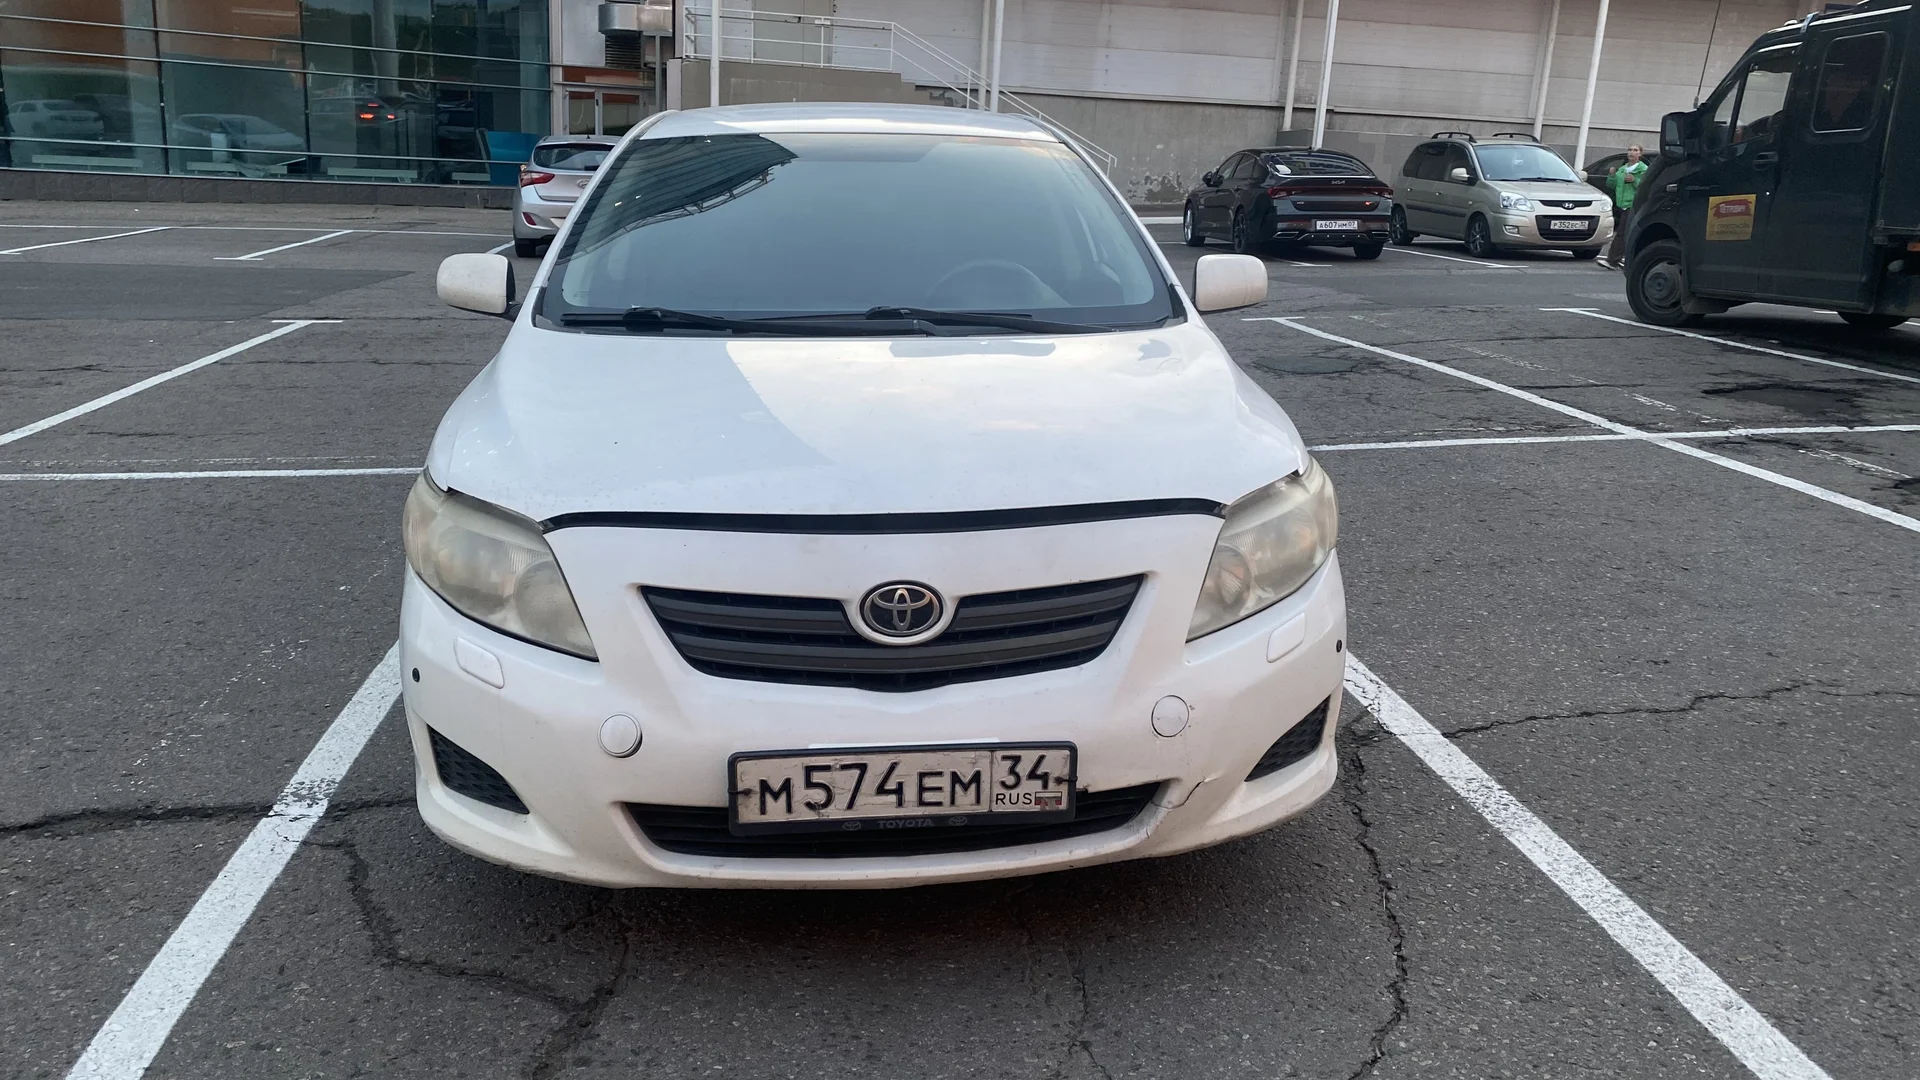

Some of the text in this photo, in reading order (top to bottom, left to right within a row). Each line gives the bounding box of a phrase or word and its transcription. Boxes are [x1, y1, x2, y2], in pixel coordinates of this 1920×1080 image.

[759, 754, 1050, 815] М574ЕМ 34
[995, 792, 1033, 805] RUS
[877, 818, 935, 829] TOYOTA
